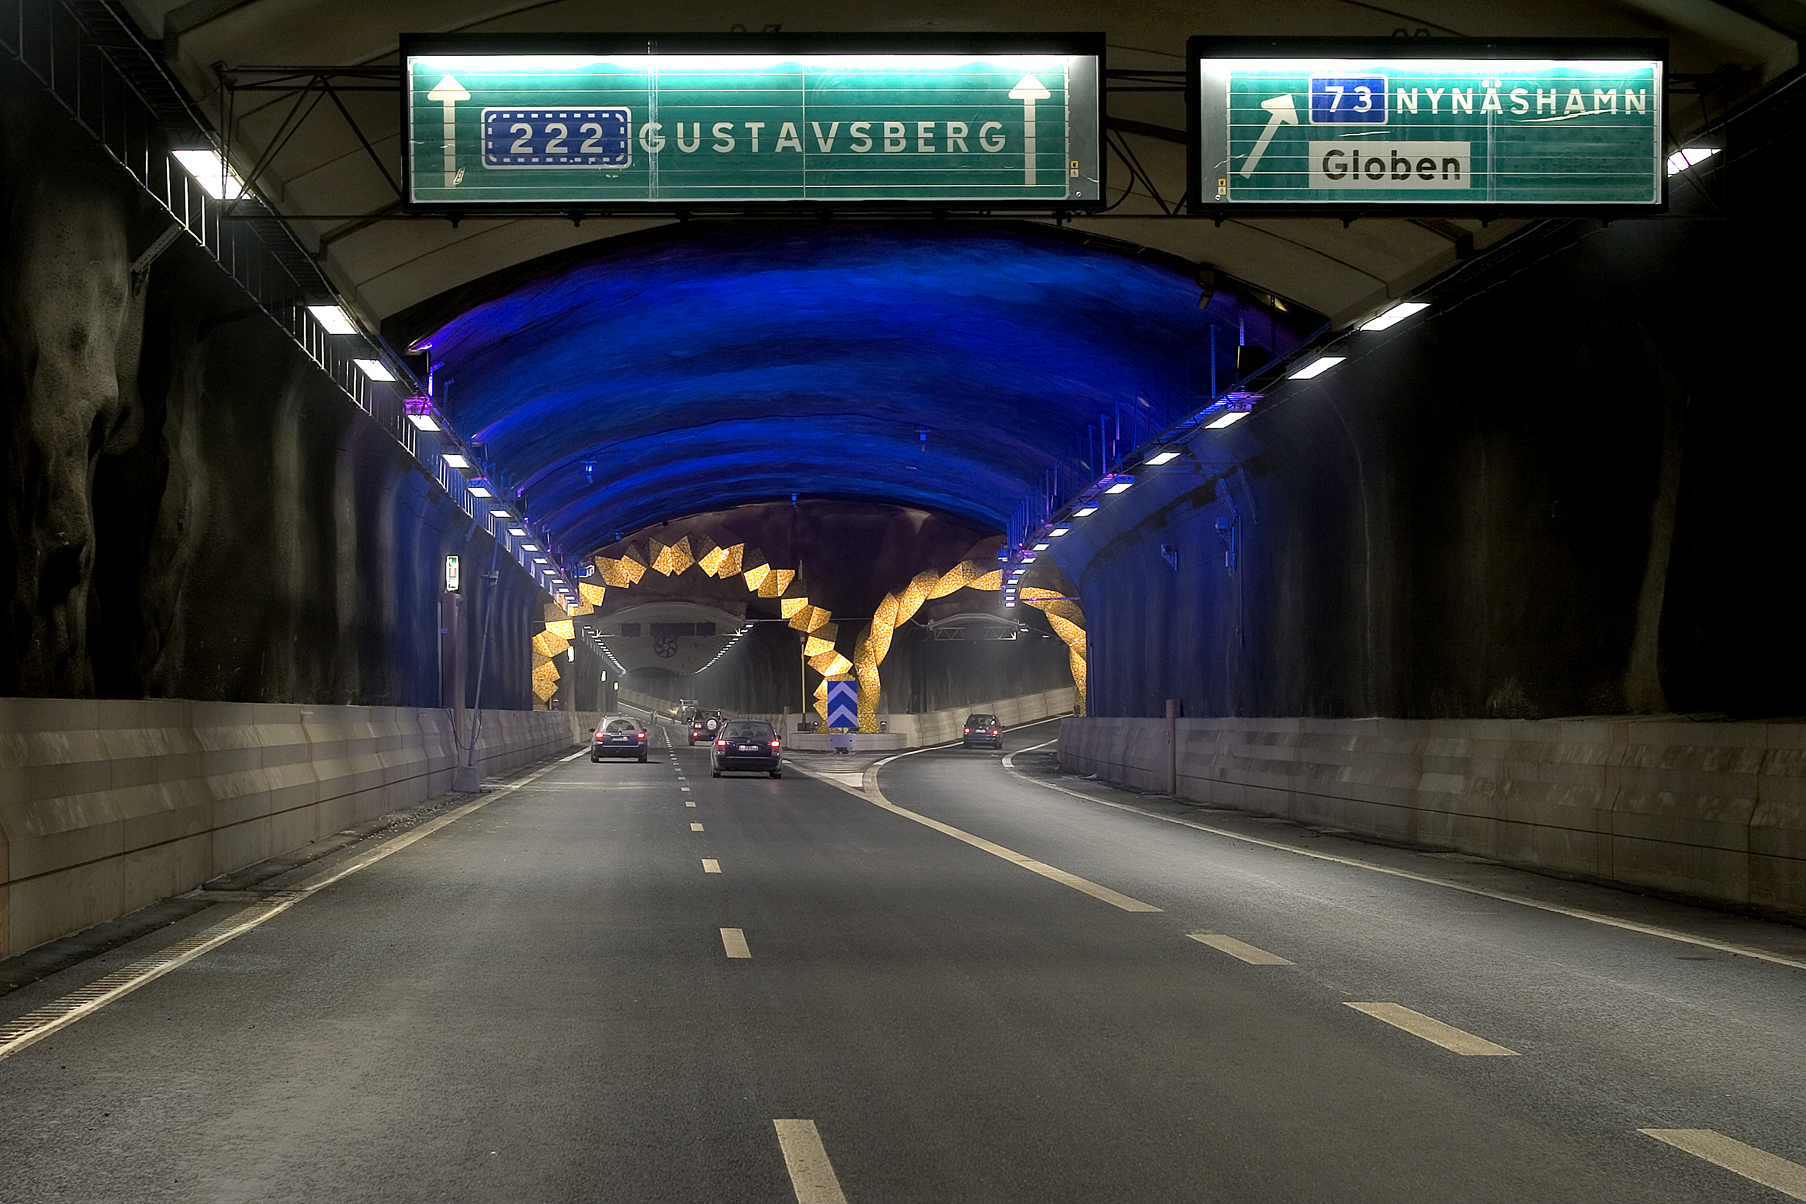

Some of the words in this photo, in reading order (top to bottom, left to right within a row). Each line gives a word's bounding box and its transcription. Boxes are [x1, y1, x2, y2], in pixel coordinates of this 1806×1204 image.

[1324, 85, 1373, 113] 73
[1396, 79, 1647, 115] NYNÄSHAMN
[509, 122, 604, 154] 222
[639, 121, 1007, 154] GUSTAVSBERG
[1322, 149, 1461, 181] Globen
